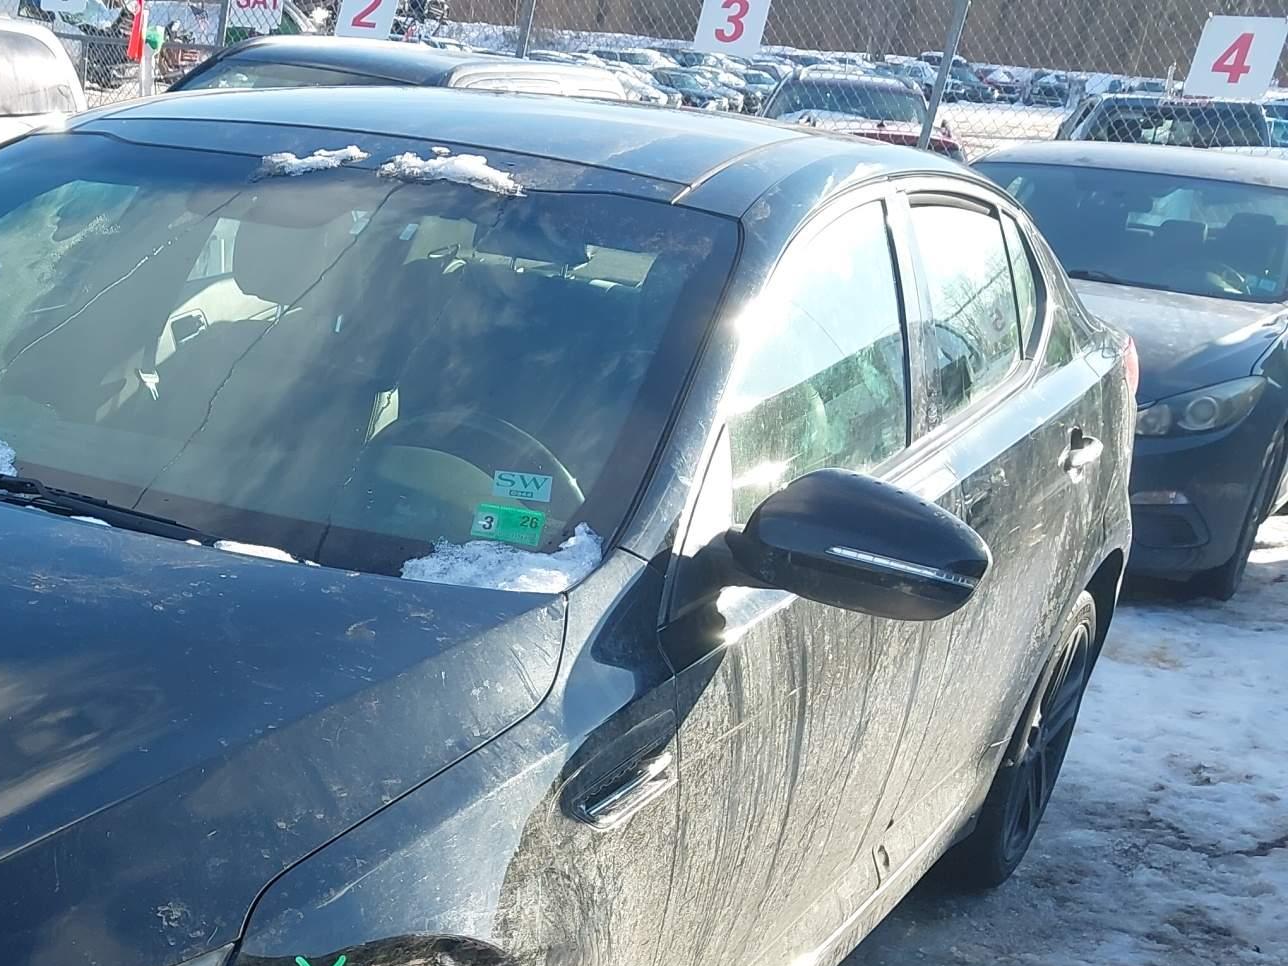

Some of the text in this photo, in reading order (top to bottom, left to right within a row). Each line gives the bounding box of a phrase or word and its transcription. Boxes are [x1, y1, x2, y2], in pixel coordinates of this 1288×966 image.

[351, 0, 383, 29] 2
[715, 0, 750, 43] 3
[1211, 32, 1255, 84] 4
[496, 473, 549, 490] SW
[482, 515, 539, 530] 3 26
